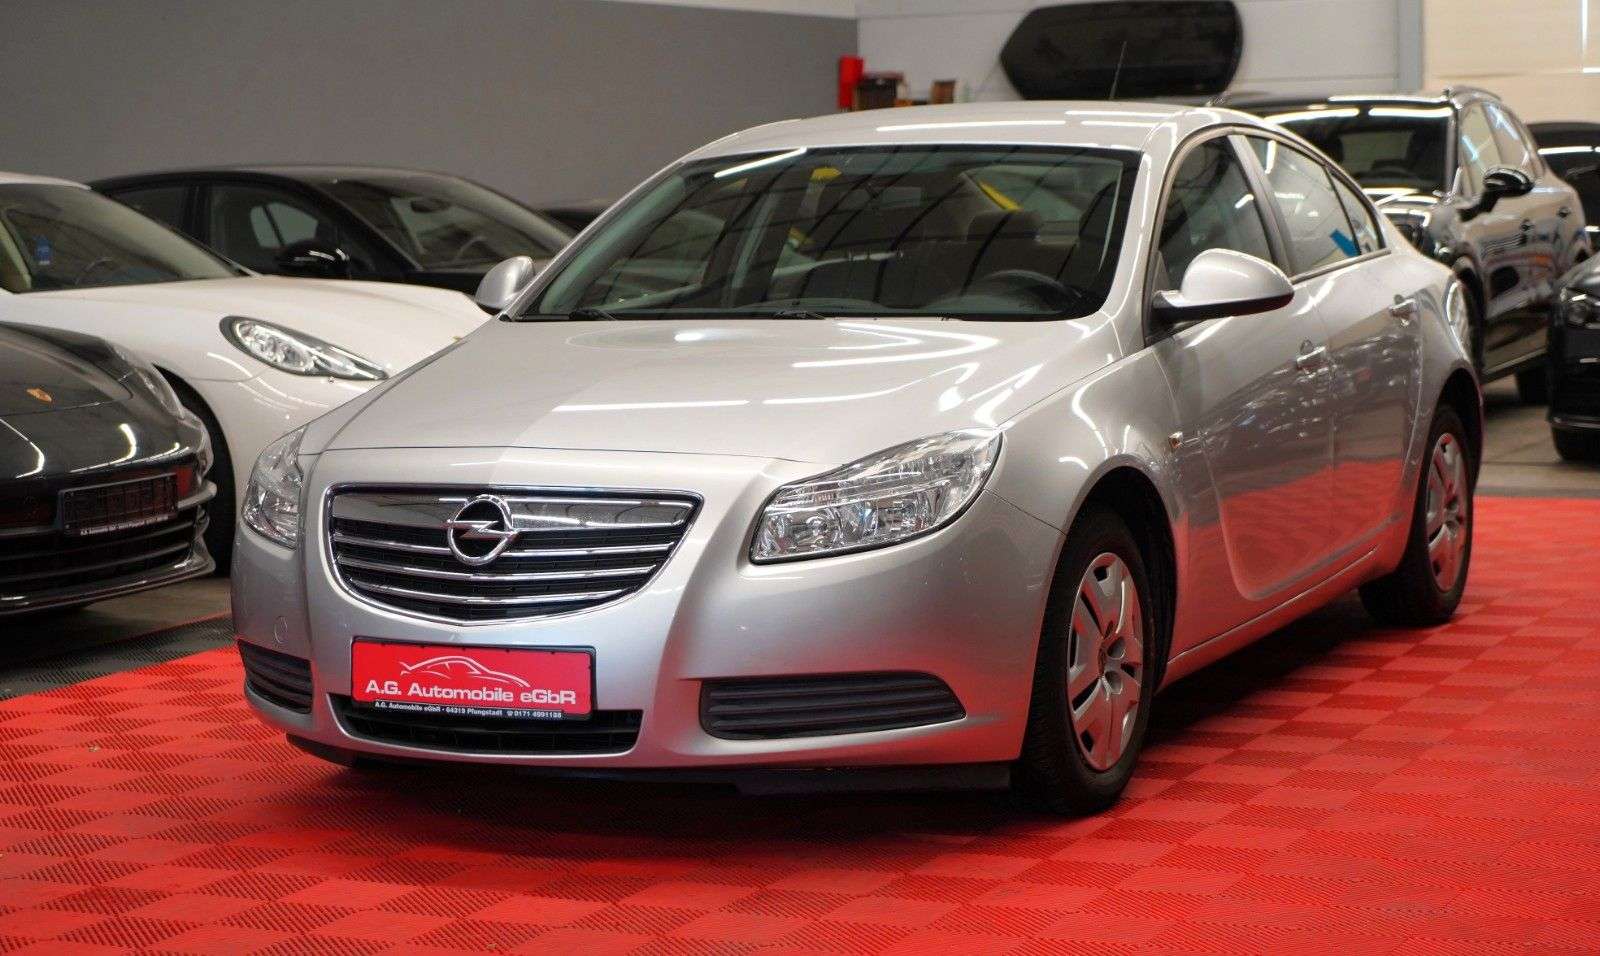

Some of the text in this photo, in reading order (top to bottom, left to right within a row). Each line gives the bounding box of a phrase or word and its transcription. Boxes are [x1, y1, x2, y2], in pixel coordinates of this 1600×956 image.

[365, 680, 577, 705] A.G. Automobile eGbR
[388, 702, 423, 712] Automobile
[467, 707, 503, 717] Pfungstadt
